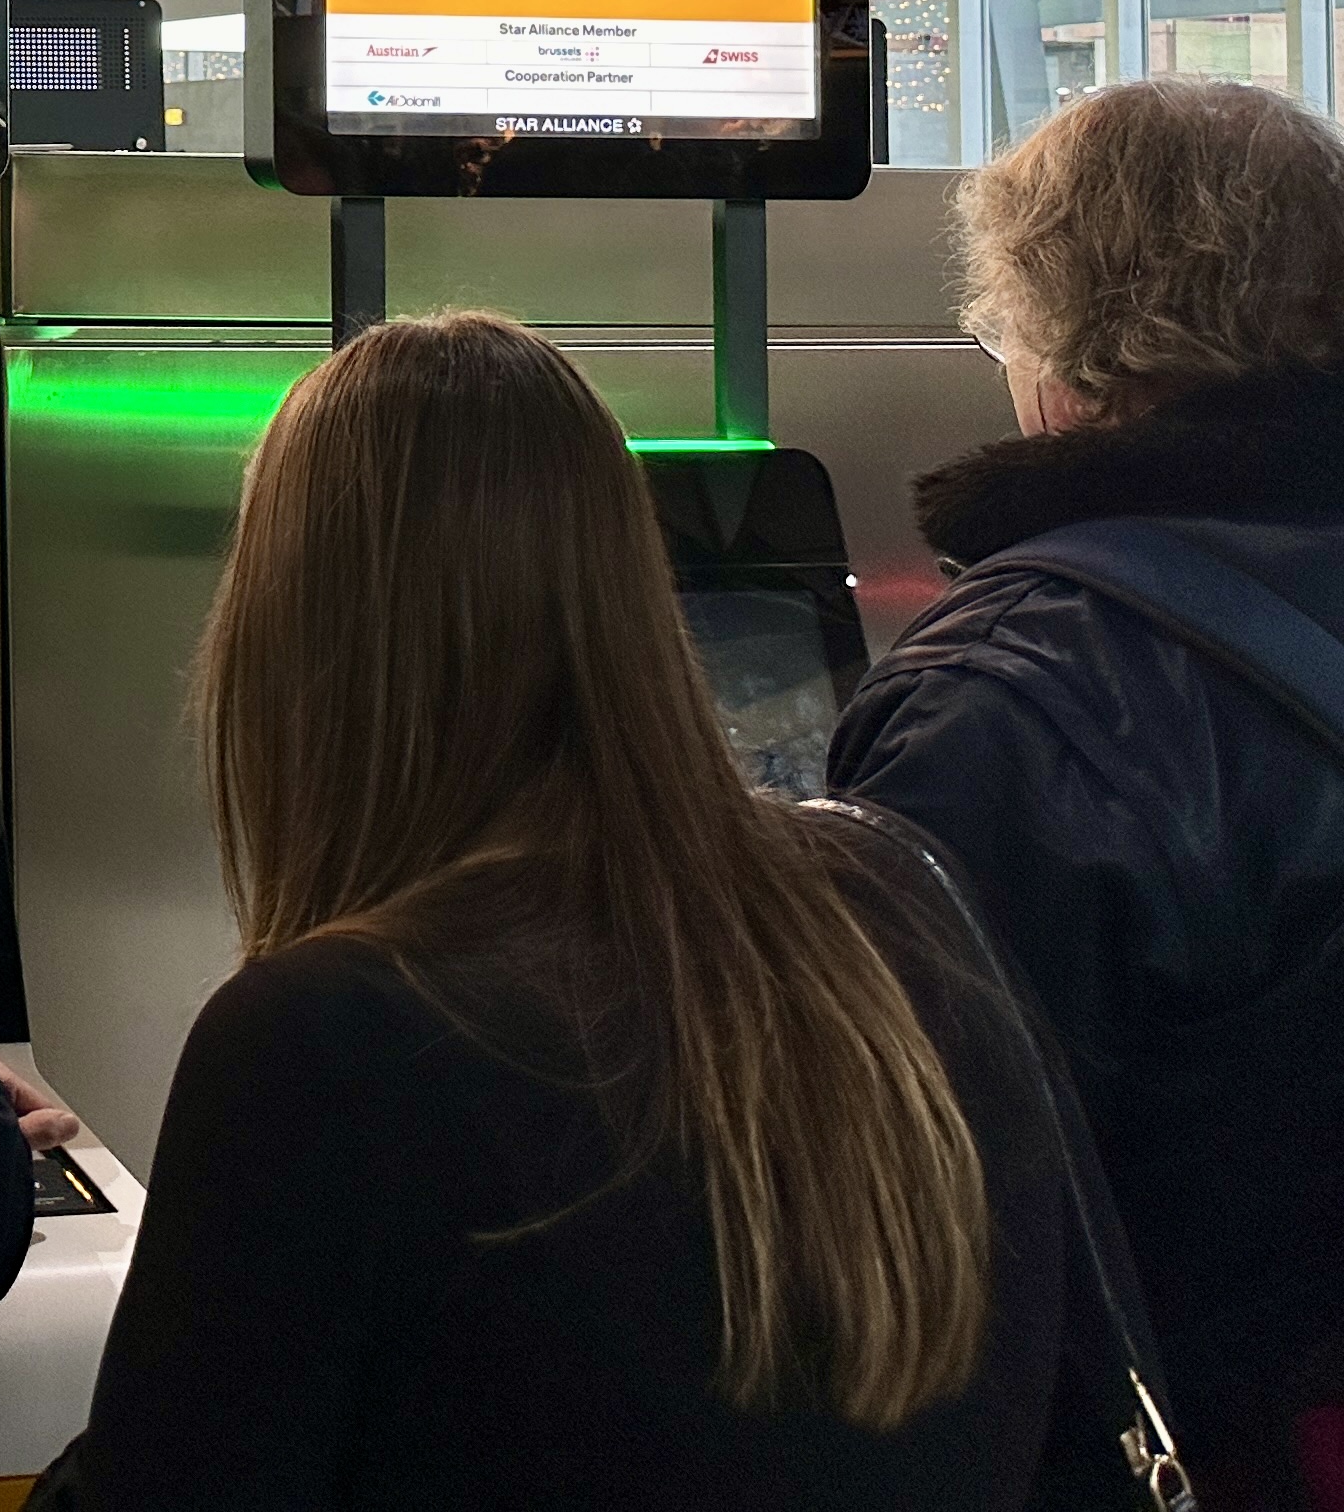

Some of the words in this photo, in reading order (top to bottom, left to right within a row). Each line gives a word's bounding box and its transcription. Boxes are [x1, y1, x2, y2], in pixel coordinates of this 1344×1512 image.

[499, 23, 527, 35] Star
[529, 23, 580, 36] Alliance
[582, 25, 638, 37] Member
[365, 44, 419, 58] Austrian
[537, 45, 582, 56] brussels
[720, 51, 759, 63] SWISS
[504, 69, 585, 84] Cooperation
[587, 71, 634, 84] Partner
[495, 117, 539, 131] STAR
[541, 118, 624, 133] ALLIANCE
